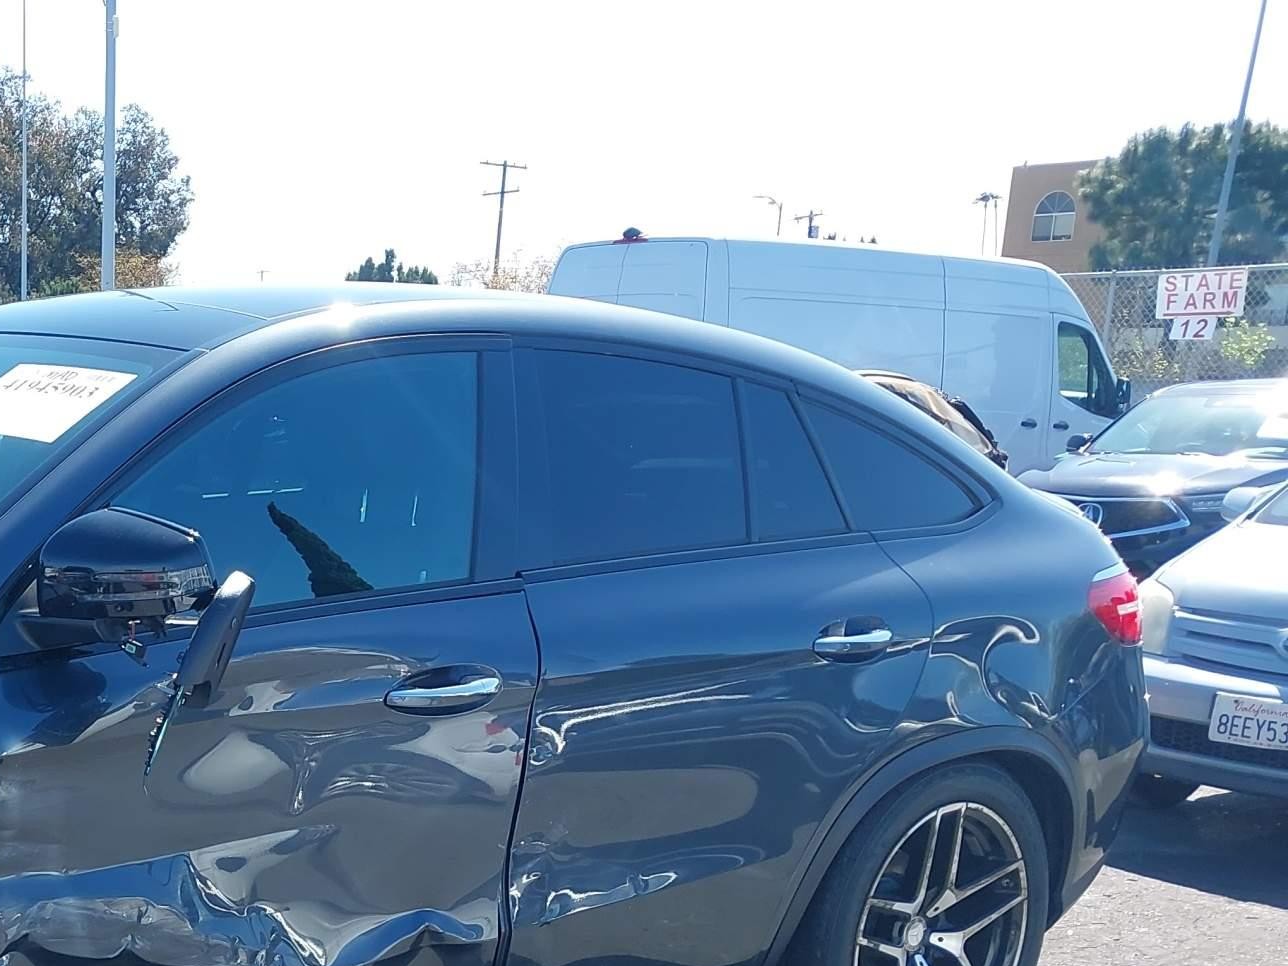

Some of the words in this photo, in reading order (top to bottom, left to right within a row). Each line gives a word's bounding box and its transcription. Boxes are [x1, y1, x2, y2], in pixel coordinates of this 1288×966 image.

[1164, 271, 1244, 292] STATE
[1166, 290, 1239, 311] FARM
[1179, 318, 1209, 338] 12
[1216, 713, 1288, 745] 8EEY53
